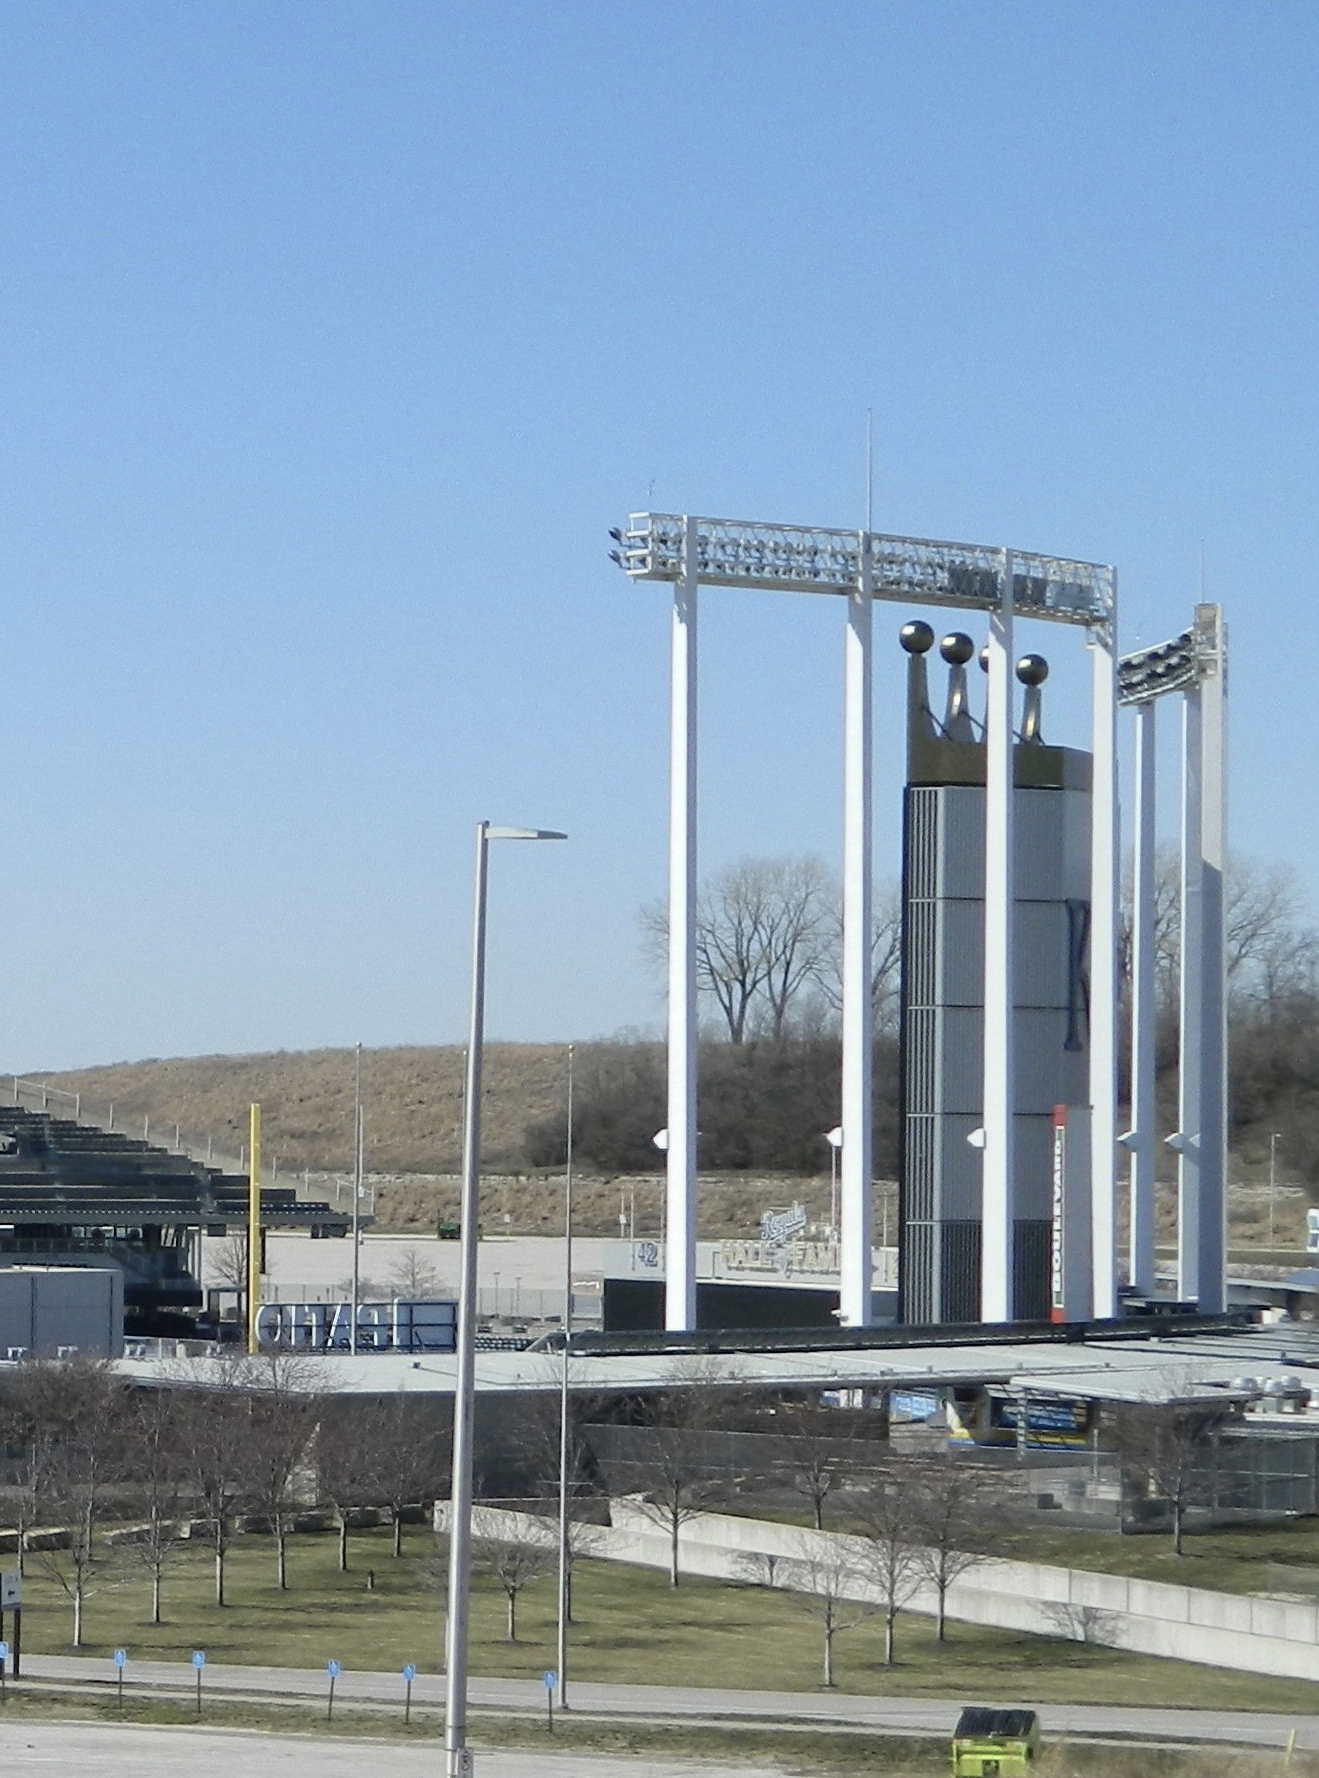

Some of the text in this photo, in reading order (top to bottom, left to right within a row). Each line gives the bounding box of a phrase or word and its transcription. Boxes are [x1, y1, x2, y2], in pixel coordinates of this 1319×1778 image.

[720, 1240, 773, 1267] HALL
[790, 1241, 841, 1270] FAM
[1053, 1139, 1062, 1292] BOULEVARD
